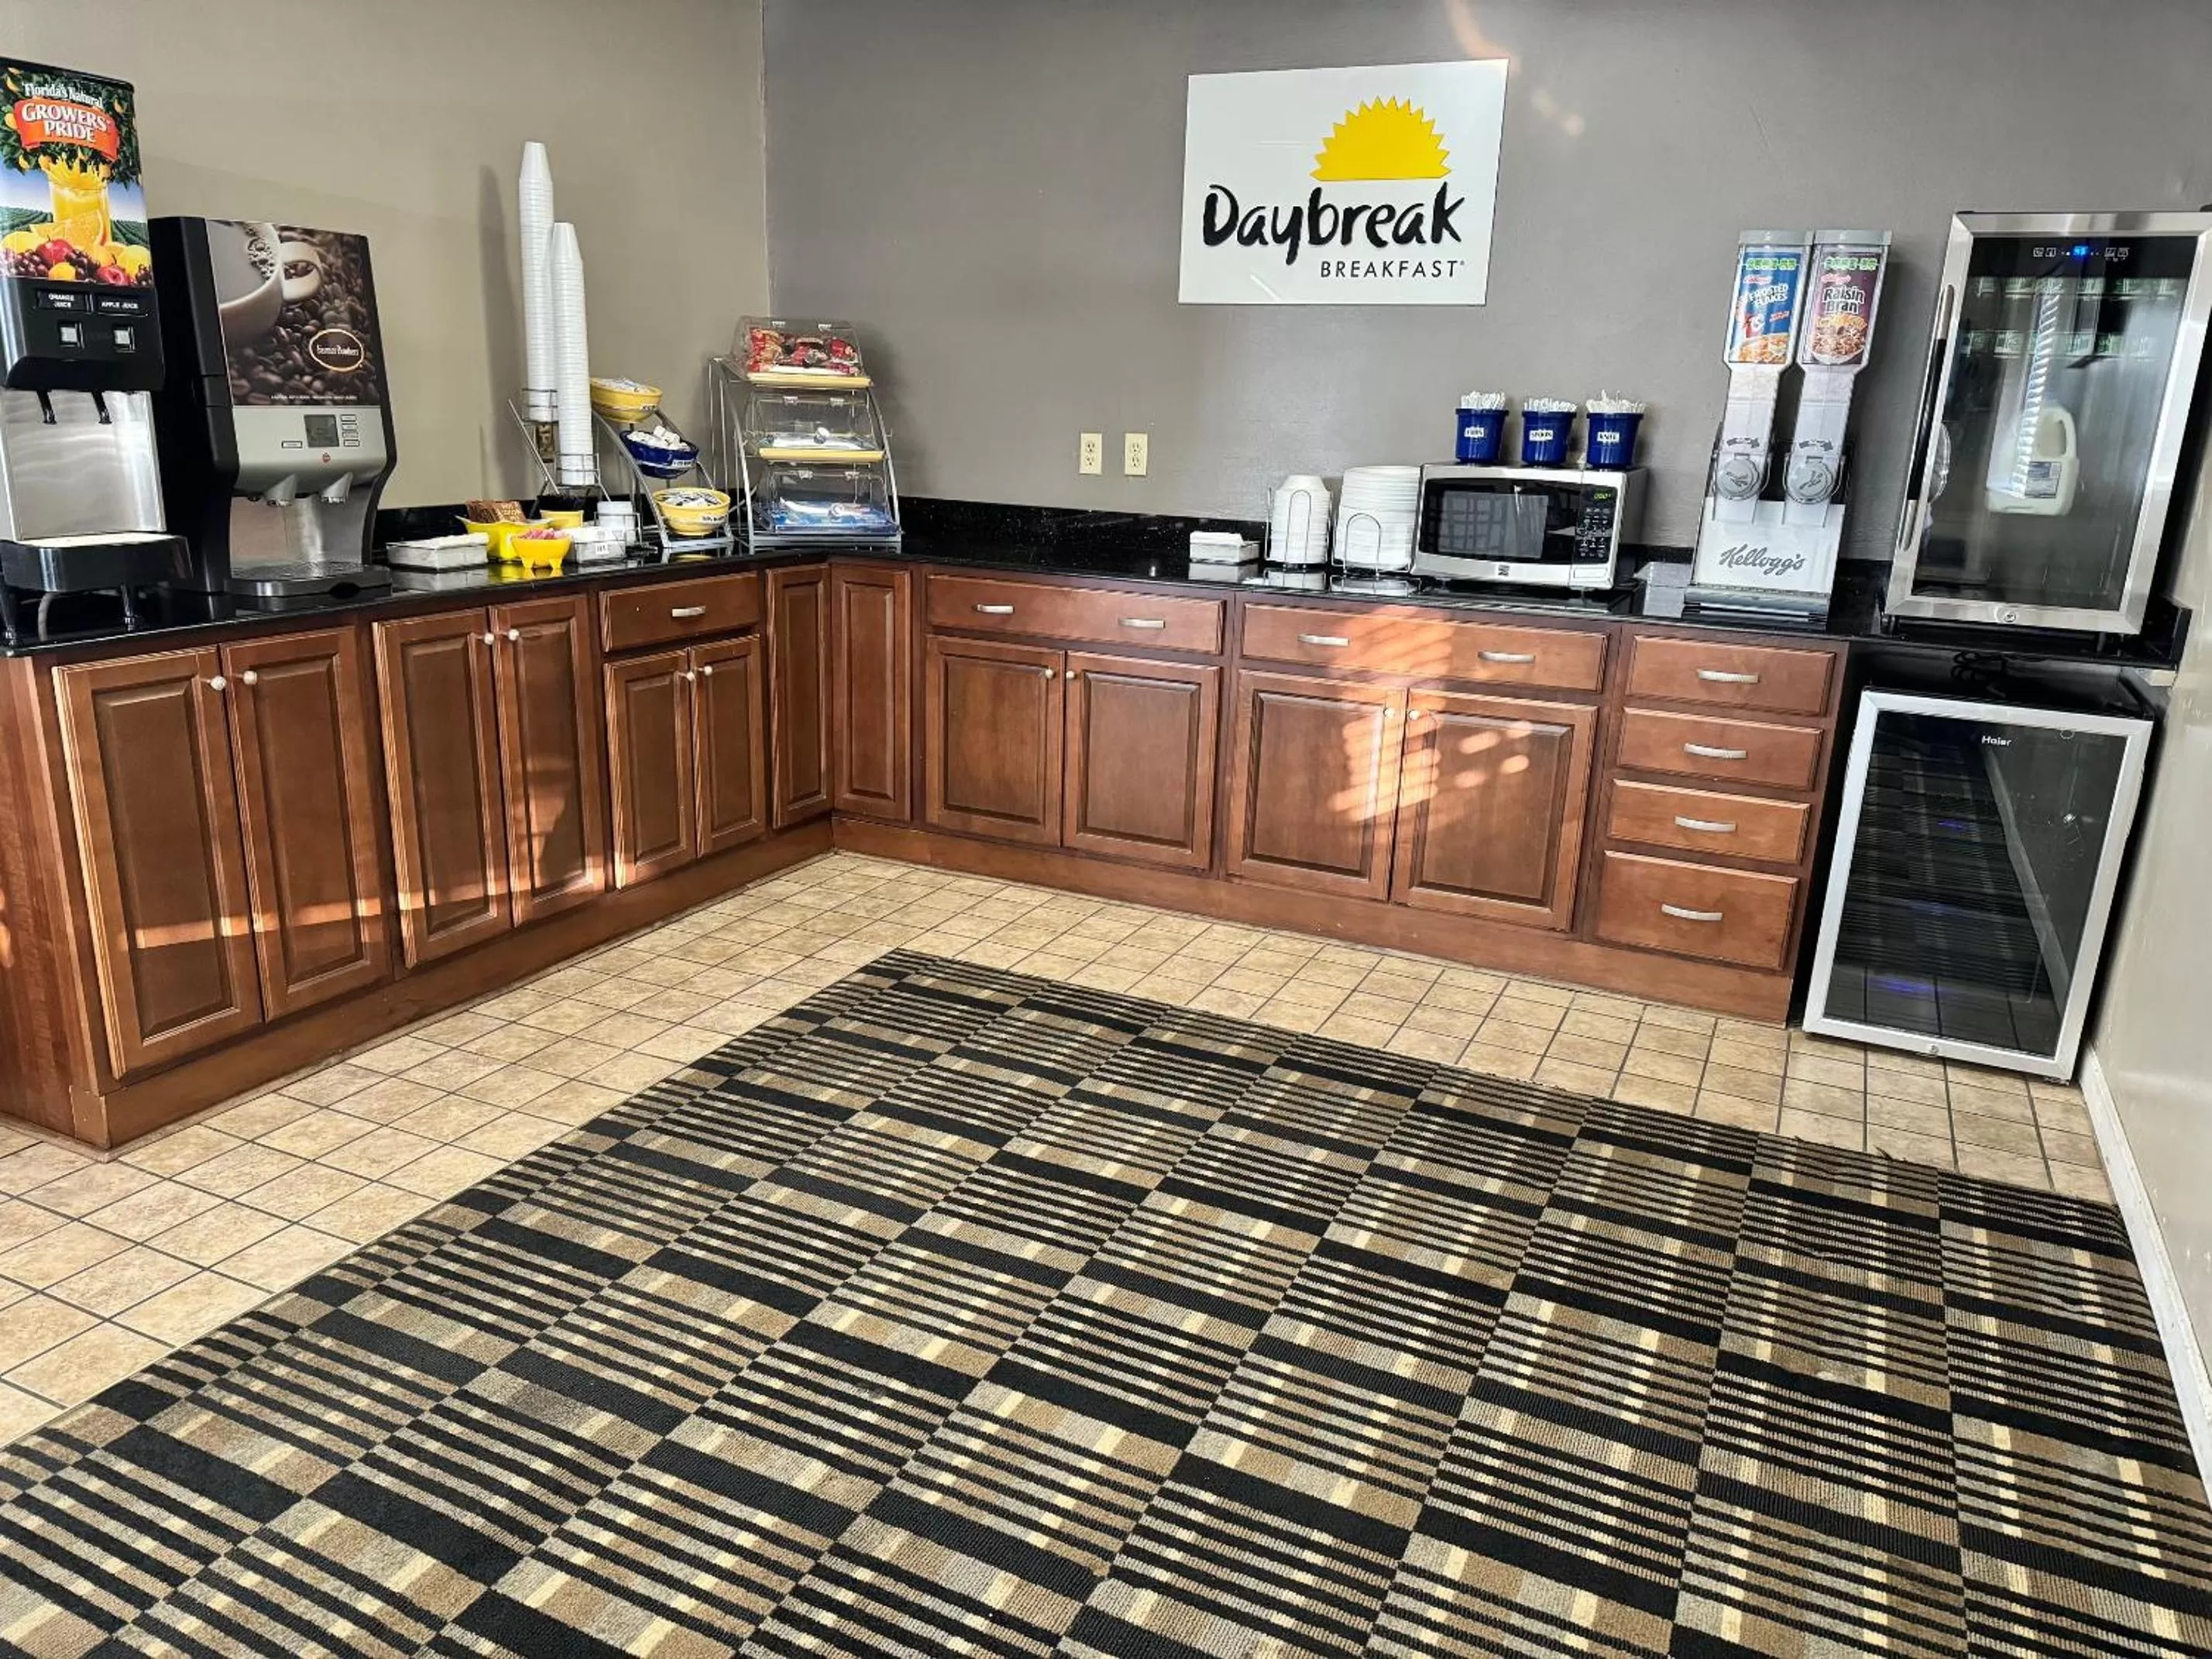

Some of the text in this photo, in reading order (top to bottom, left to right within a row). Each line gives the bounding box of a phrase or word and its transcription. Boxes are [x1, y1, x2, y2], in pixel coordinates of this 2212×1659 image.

[68, 87, 104, 108] Natural
[43, 121, 96, 143] PRIDE
[1202, 180, 1466, 266] Daybreak
[1320, 259, 1460, 279] BREAKFAST
[1822, 283, 1866, 305] Raisin
[1824, 300, 1859, 315] Bran
[1718, 543, 1806, 576] Kellogg's
[1981, 734, 2013, 747] Haier
